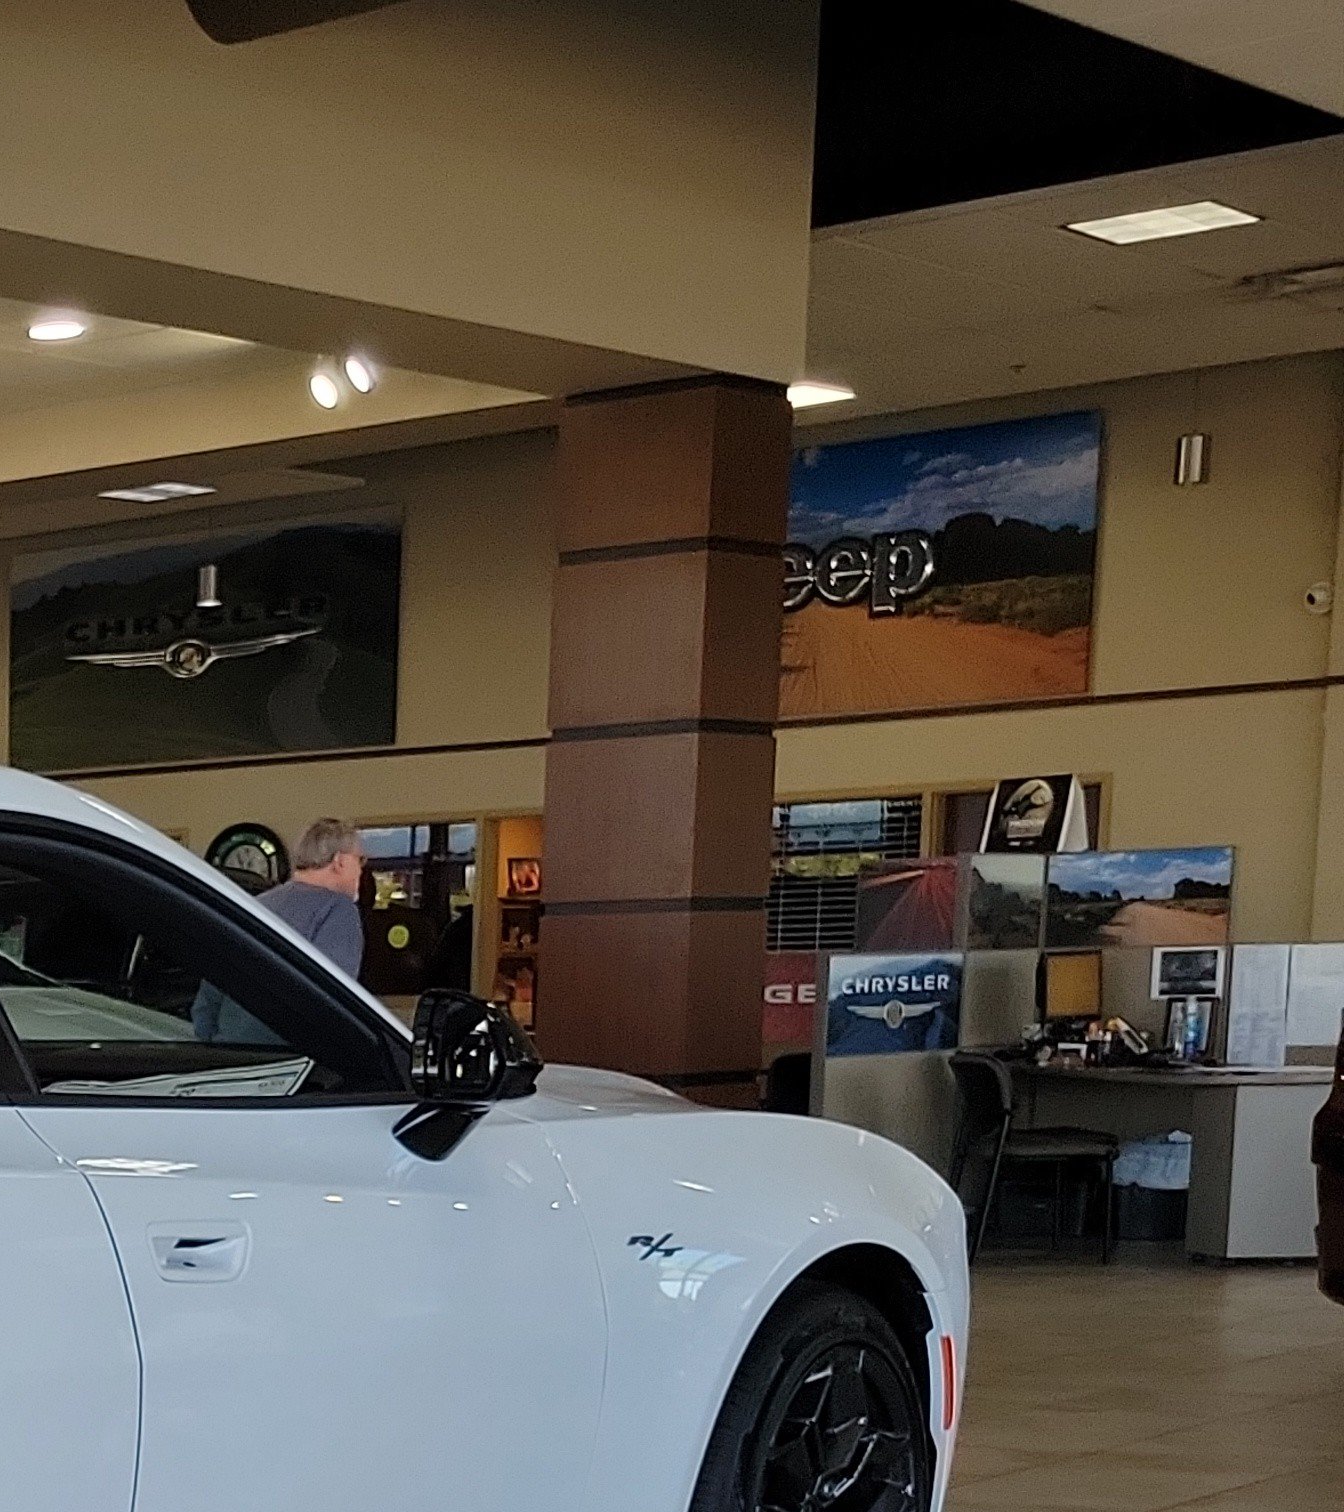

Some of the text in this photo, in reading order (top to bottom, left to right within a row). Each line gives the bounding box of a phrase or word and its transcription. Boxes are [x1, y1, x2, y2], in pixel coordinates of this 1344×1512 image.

[783, 530, 934, 617] eep
[764, 983, 817, 1004] GE
[841, 974, 951, 995] CHRYSLER
